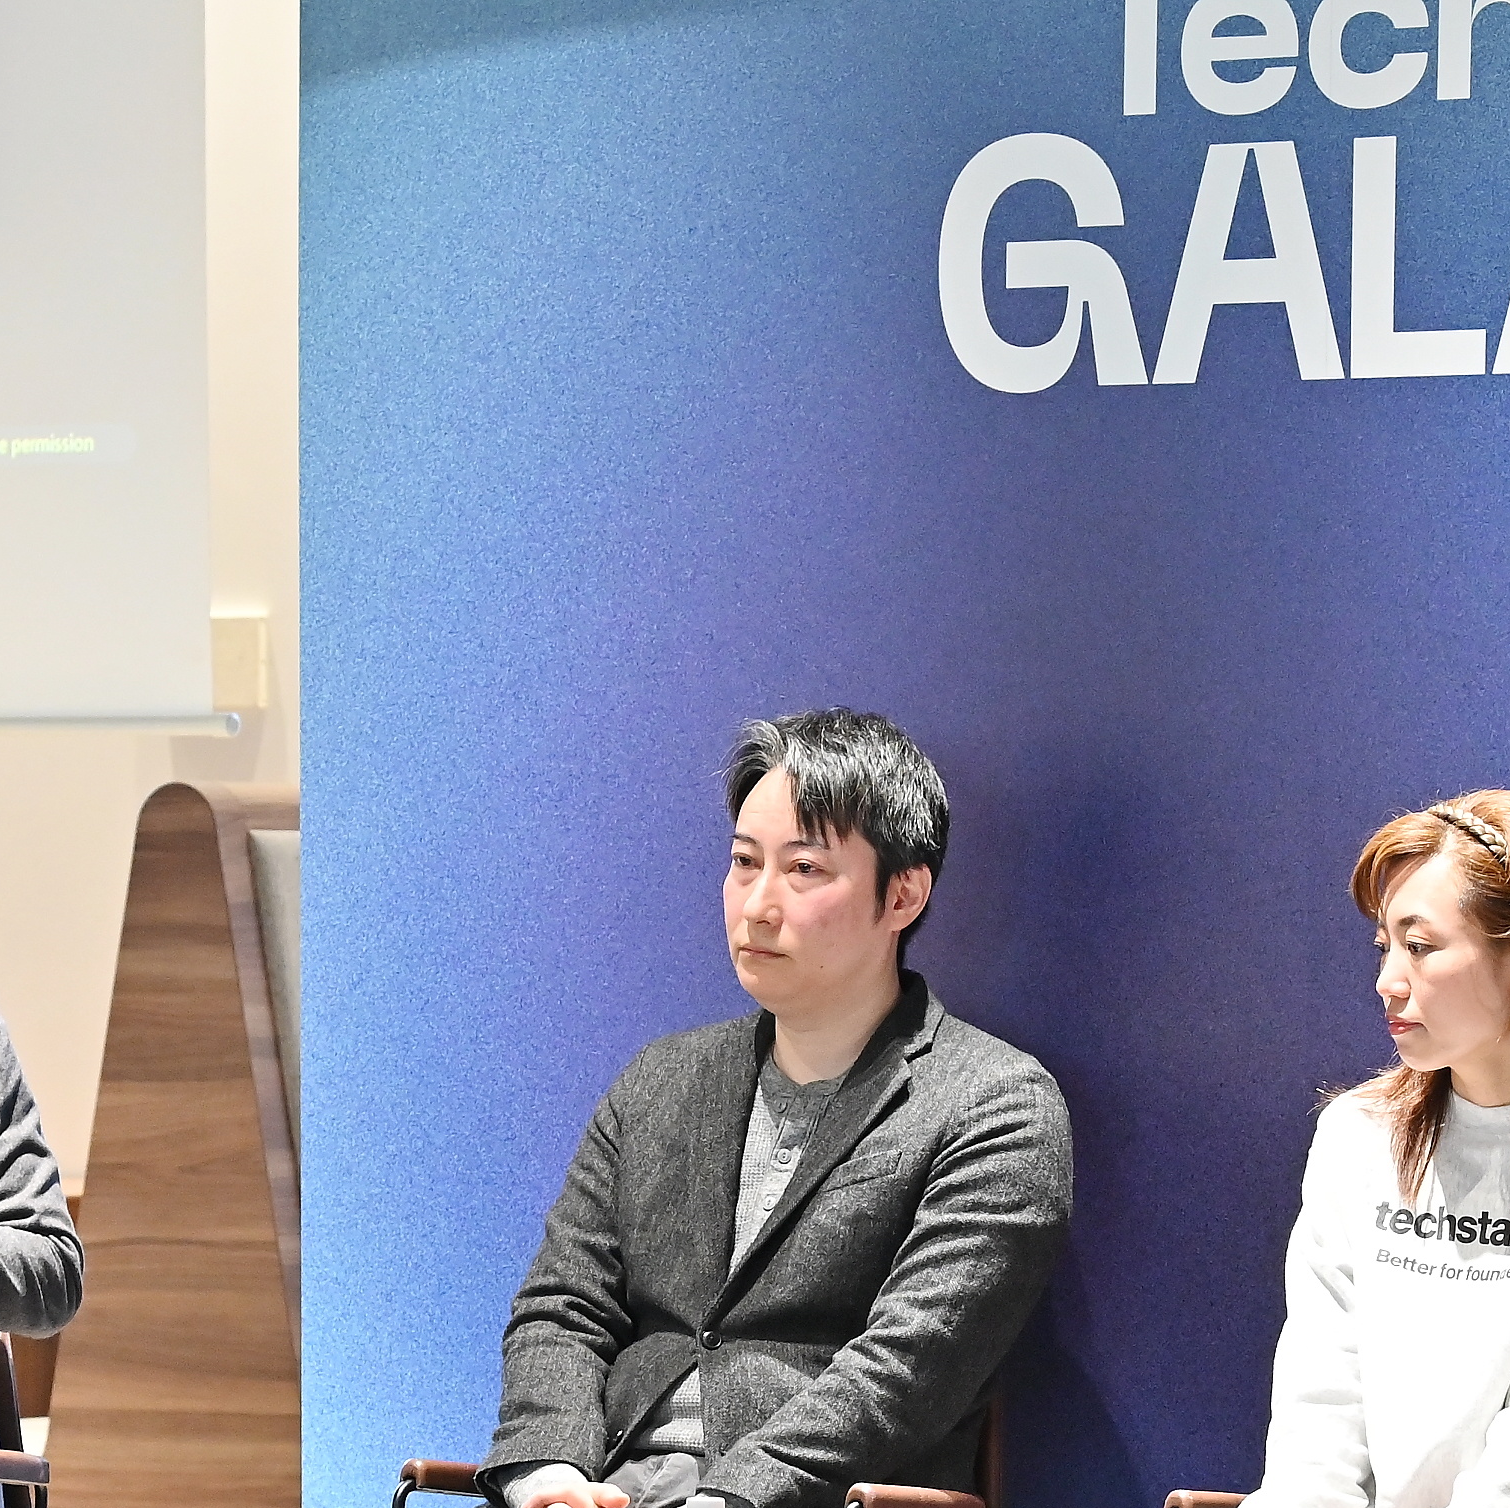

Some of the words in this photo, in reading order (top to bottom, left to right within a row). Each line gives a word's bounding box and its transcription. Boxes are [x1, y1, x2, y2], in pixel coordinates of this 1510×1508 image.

[10, 432, 95, 459] permission
[1376, 1248, 1438, 1277] Better
[1439, 1262, 1464, 1282] for
